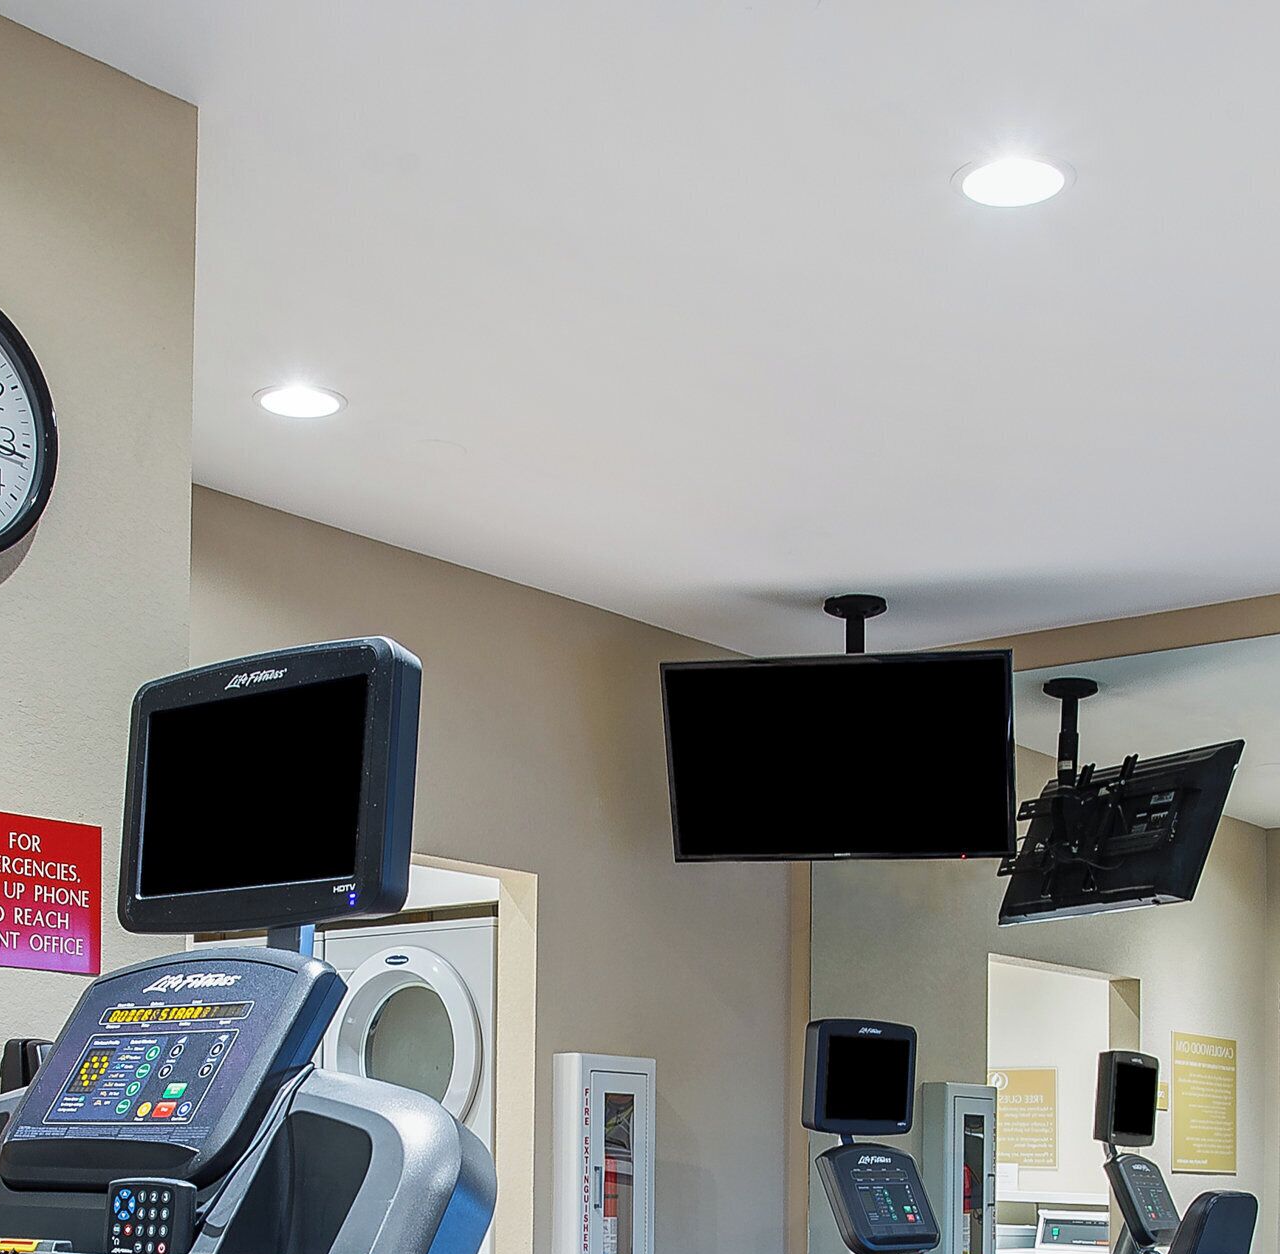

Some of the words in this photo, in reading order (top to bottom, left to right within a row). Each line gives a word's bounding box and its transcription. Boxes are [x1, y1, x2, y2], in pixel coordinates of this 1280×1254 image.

[9, 832, 41, 853] FOR
[4, 881, 25, 900] UP
[34, 884, 90, 908] PHONE
[333, 883, 356, 894] HDTV
[14, 908, 69, 930] REACH
[29, 934, 84, 956] OFFICE
